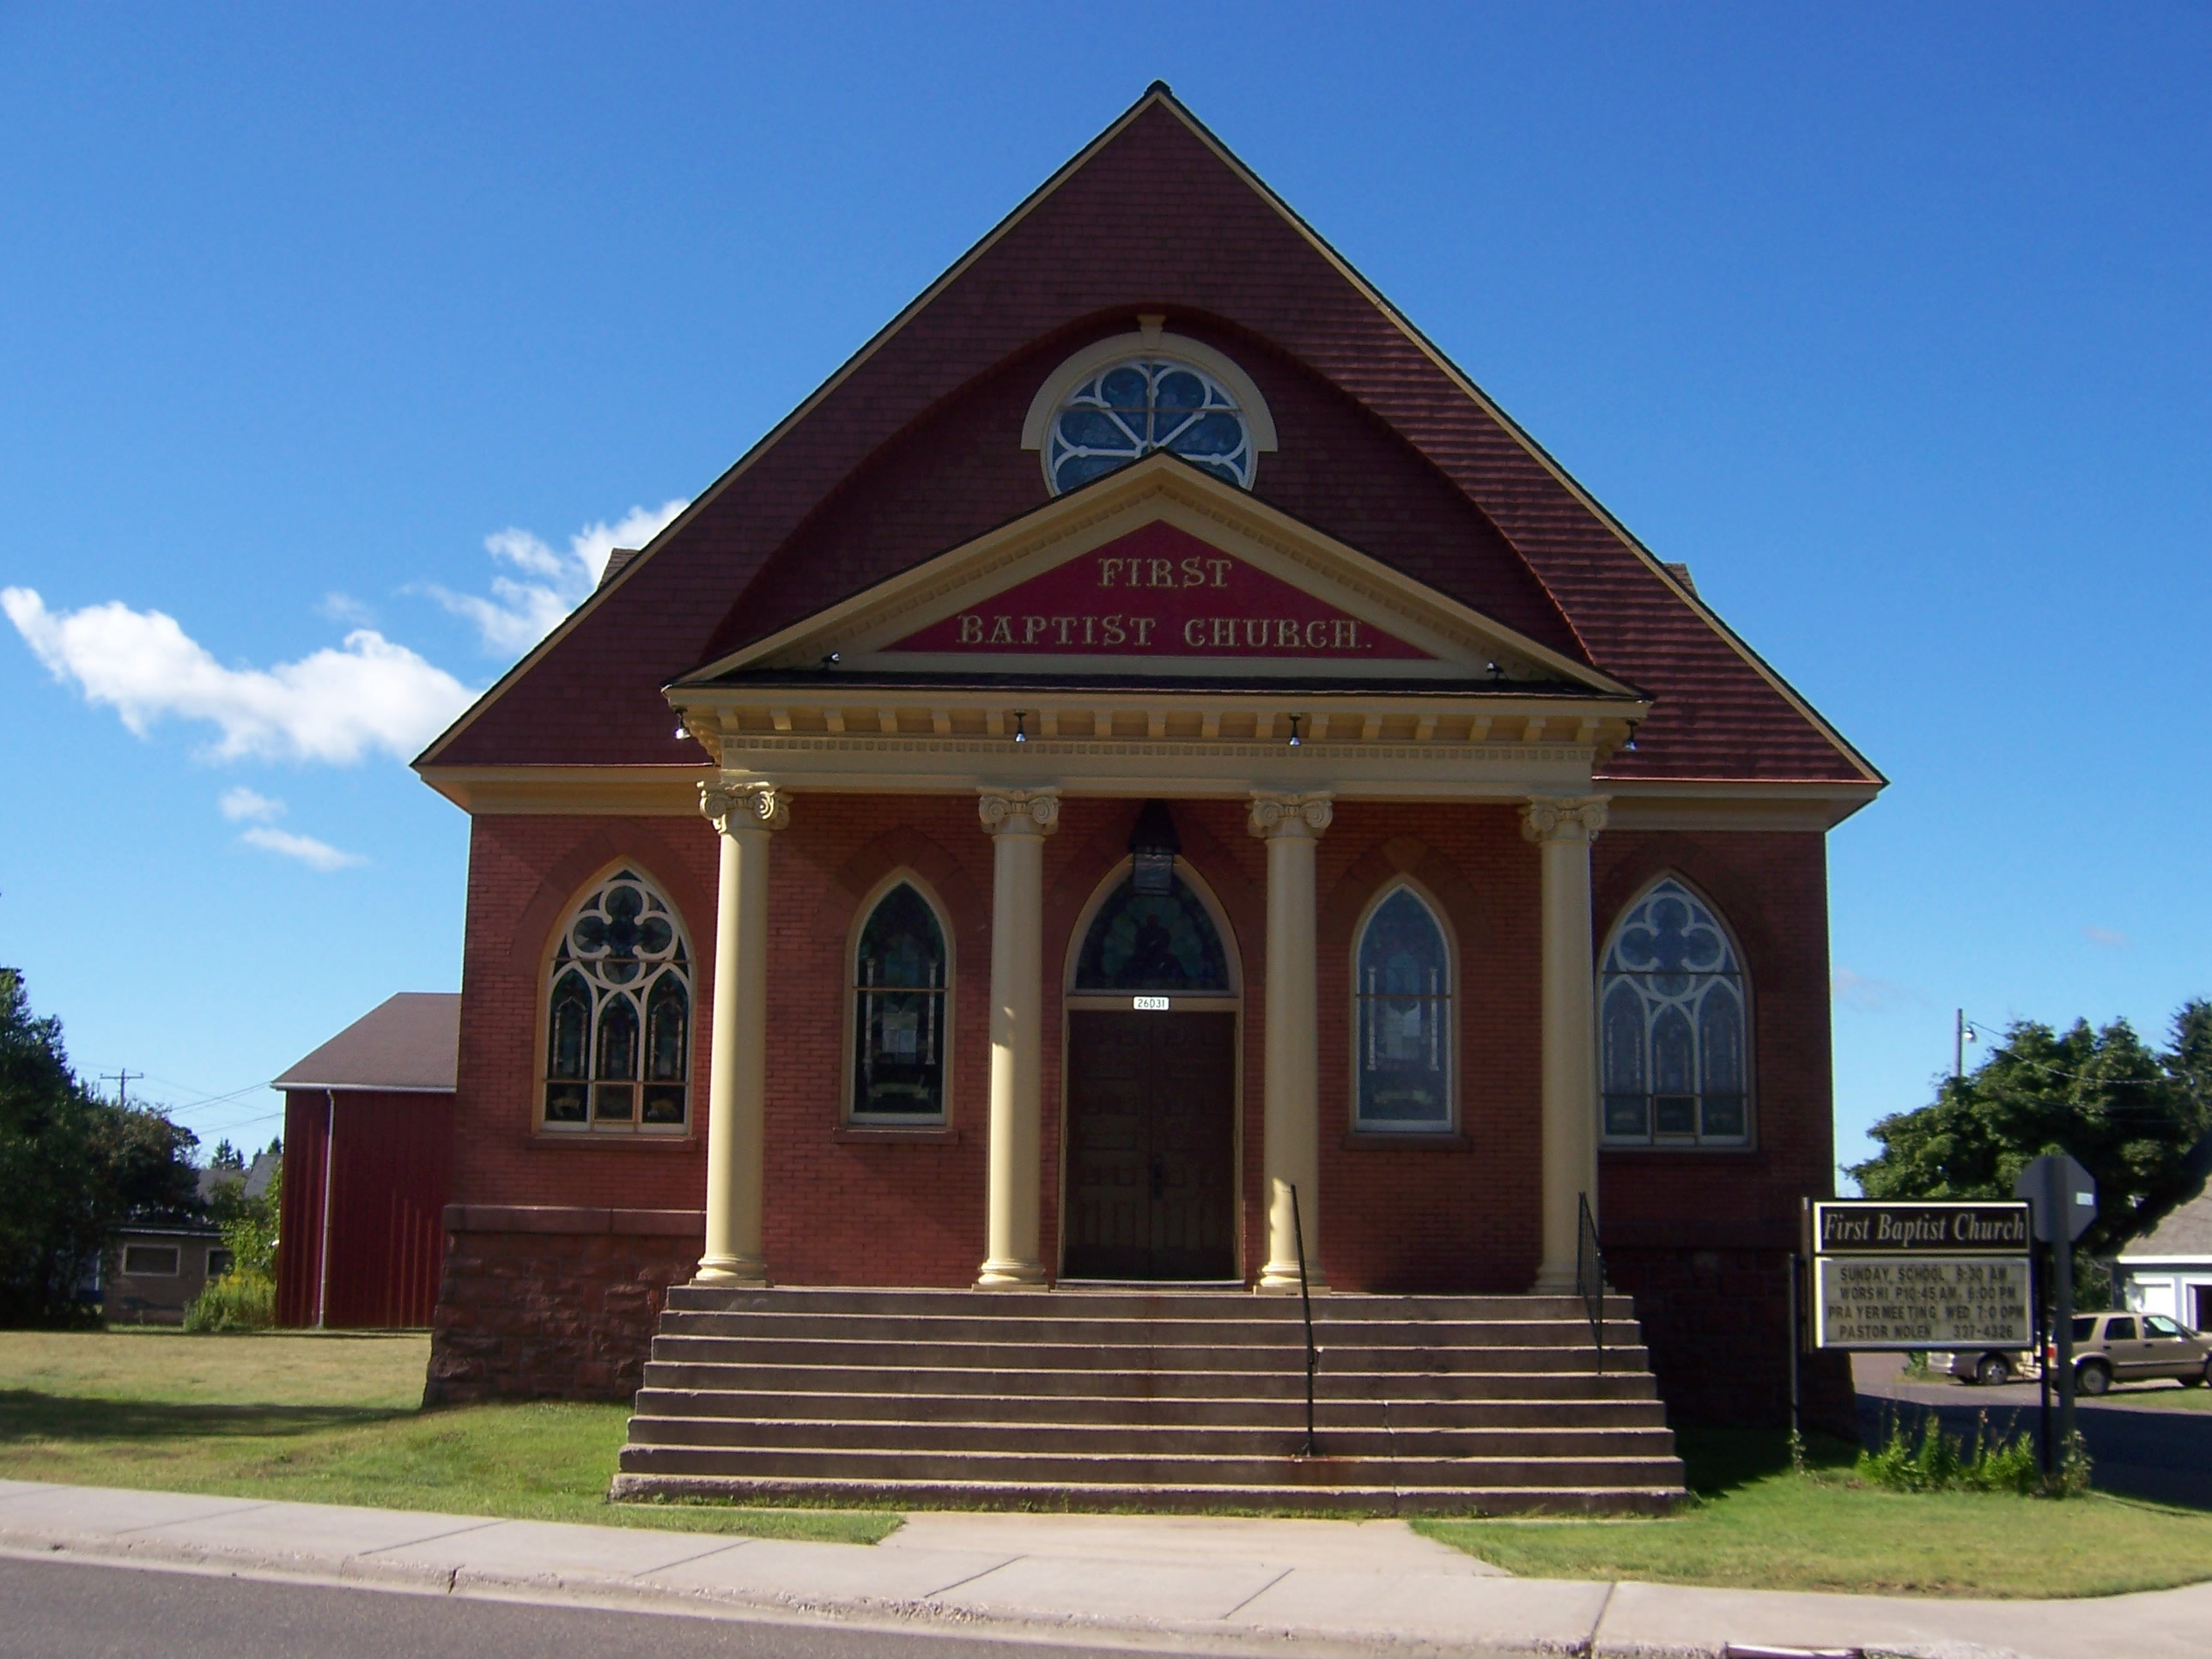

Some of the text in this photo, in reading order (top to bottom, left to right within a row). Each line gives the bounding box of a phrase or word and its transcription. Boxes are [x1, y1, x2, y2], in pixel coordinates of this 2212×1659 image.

[1097, 556, 1233, 588] FIRST
[956, 614, 1157, 646] BAPTIST
[1138, 998, 1165, 1008] 26031
[1823, 1213, 2025, 1248] First Baptist Church
[1898, 1267, 1945, 1281] SCHOOL
[1990, 1267, 2008, 1281] AM
[1839, 1325, 1888, 1339] PASTOR
